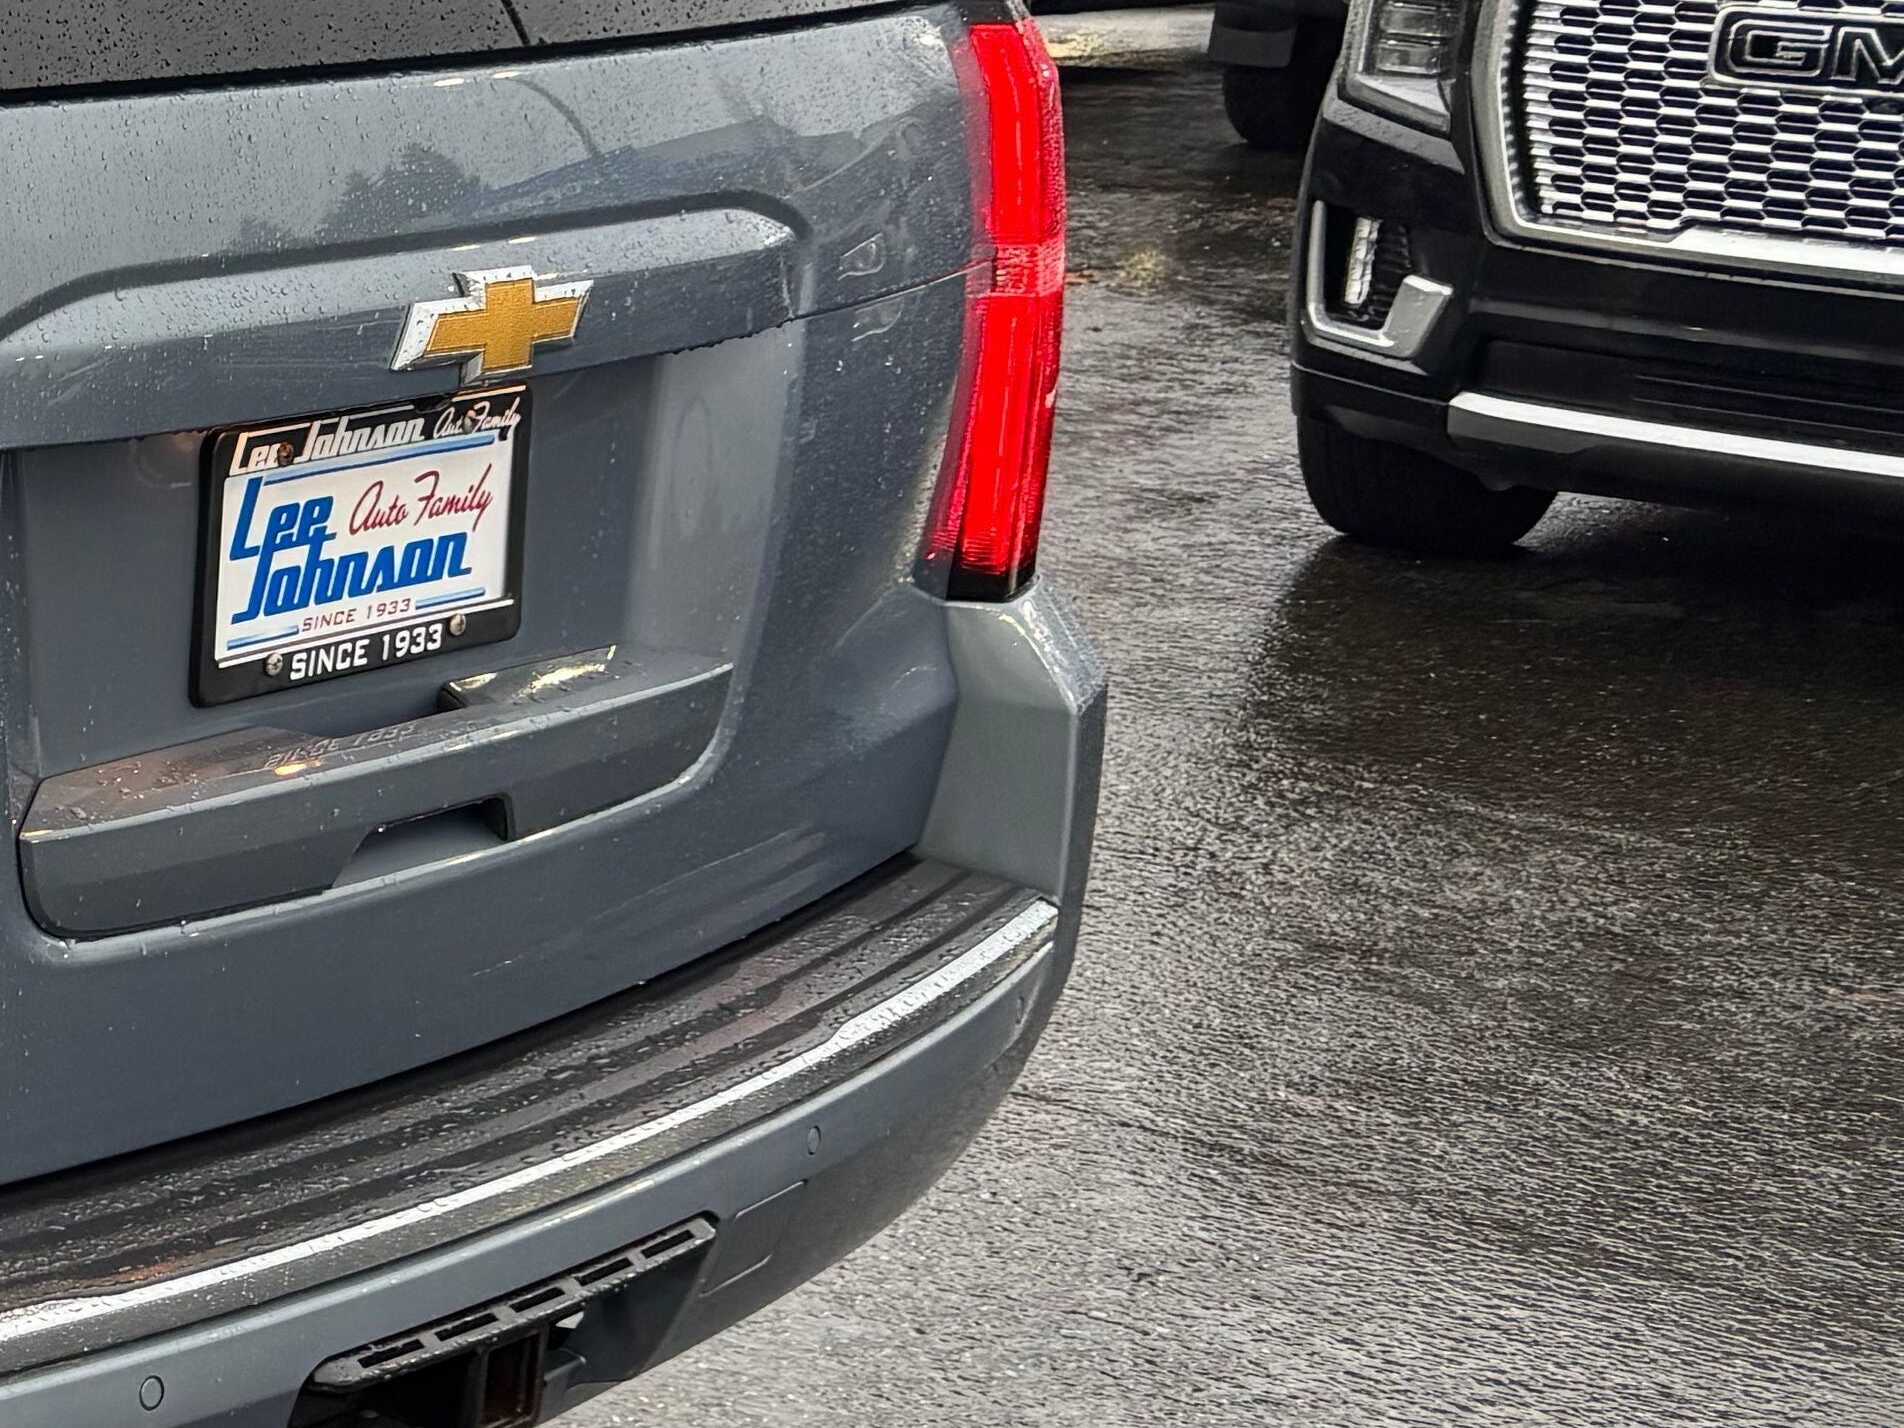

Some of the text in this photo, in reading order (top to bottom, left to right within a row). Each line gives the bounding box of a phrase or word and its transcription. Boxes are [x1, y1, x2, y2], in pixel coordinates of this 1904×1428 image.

[292, 416, 425, 464] Johnson
[433, 406, 471, 439] Aut
[473, 397, 522, 438] Family
[229, 463, 495, 561] Lee Auto Family
[231, 532, 473, 625] Johnson
[302, 597, 412, 633] SINCE 1933
[290, 622, 444, 681] SINCE 1933
